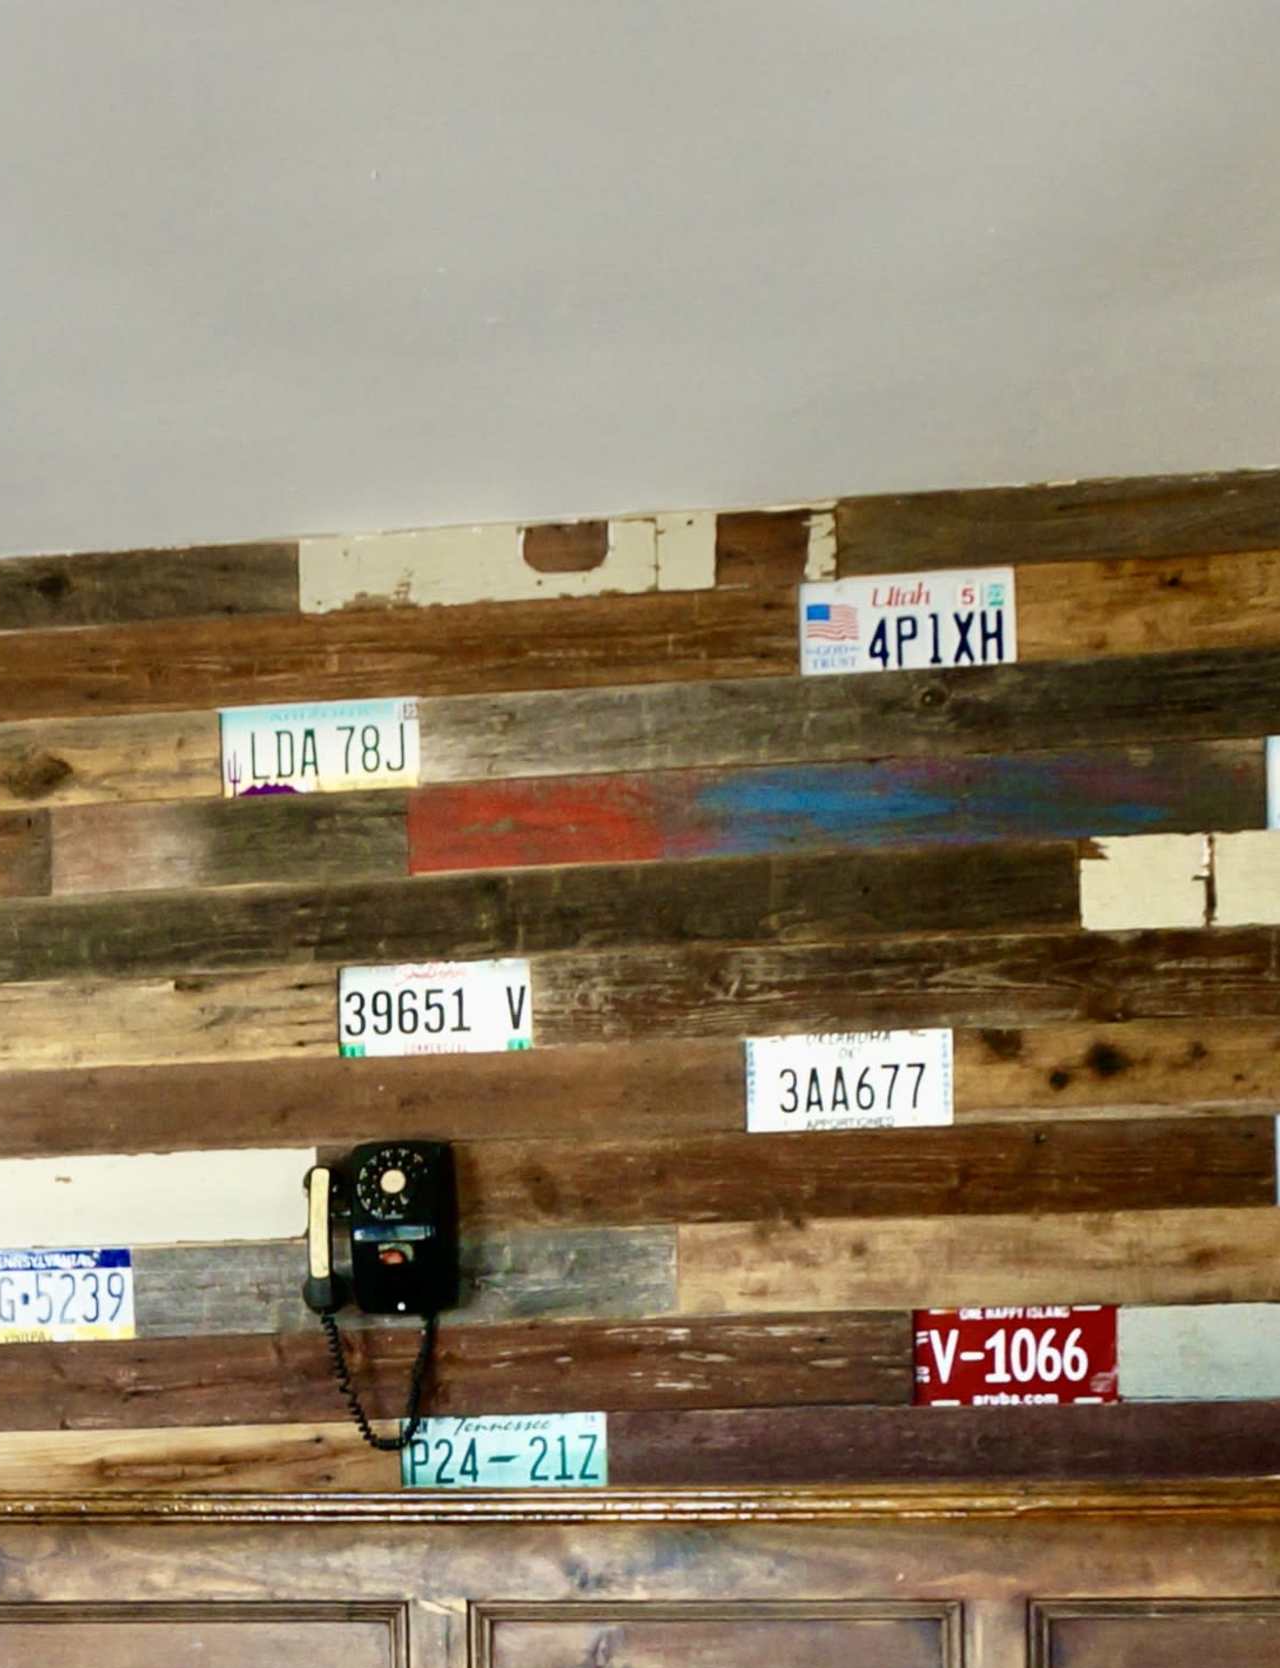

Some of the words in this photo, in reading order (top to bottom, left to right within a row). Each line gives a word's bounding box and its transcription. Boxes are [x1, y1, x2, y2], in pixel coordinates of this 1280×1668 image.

[871, 582, 930, 608] Utah
[869, 609, 1004, 668] 4P1XH
[251, 728, 319, 780] LDA
[336, 722, 405, 774] 78J
[344, 987, 471, 1036] 39651
[506, 985, 526, 1030] V
[779, 1063, 926, 1113] 3AA677
[985, 1307, 1024, 1319] HAPPY
[929, 1328, 1089, 1384] V-1066
[972, 1392, 1059, 1406] aruba.com
[454, 1418, 550, 1436] Tennessee
